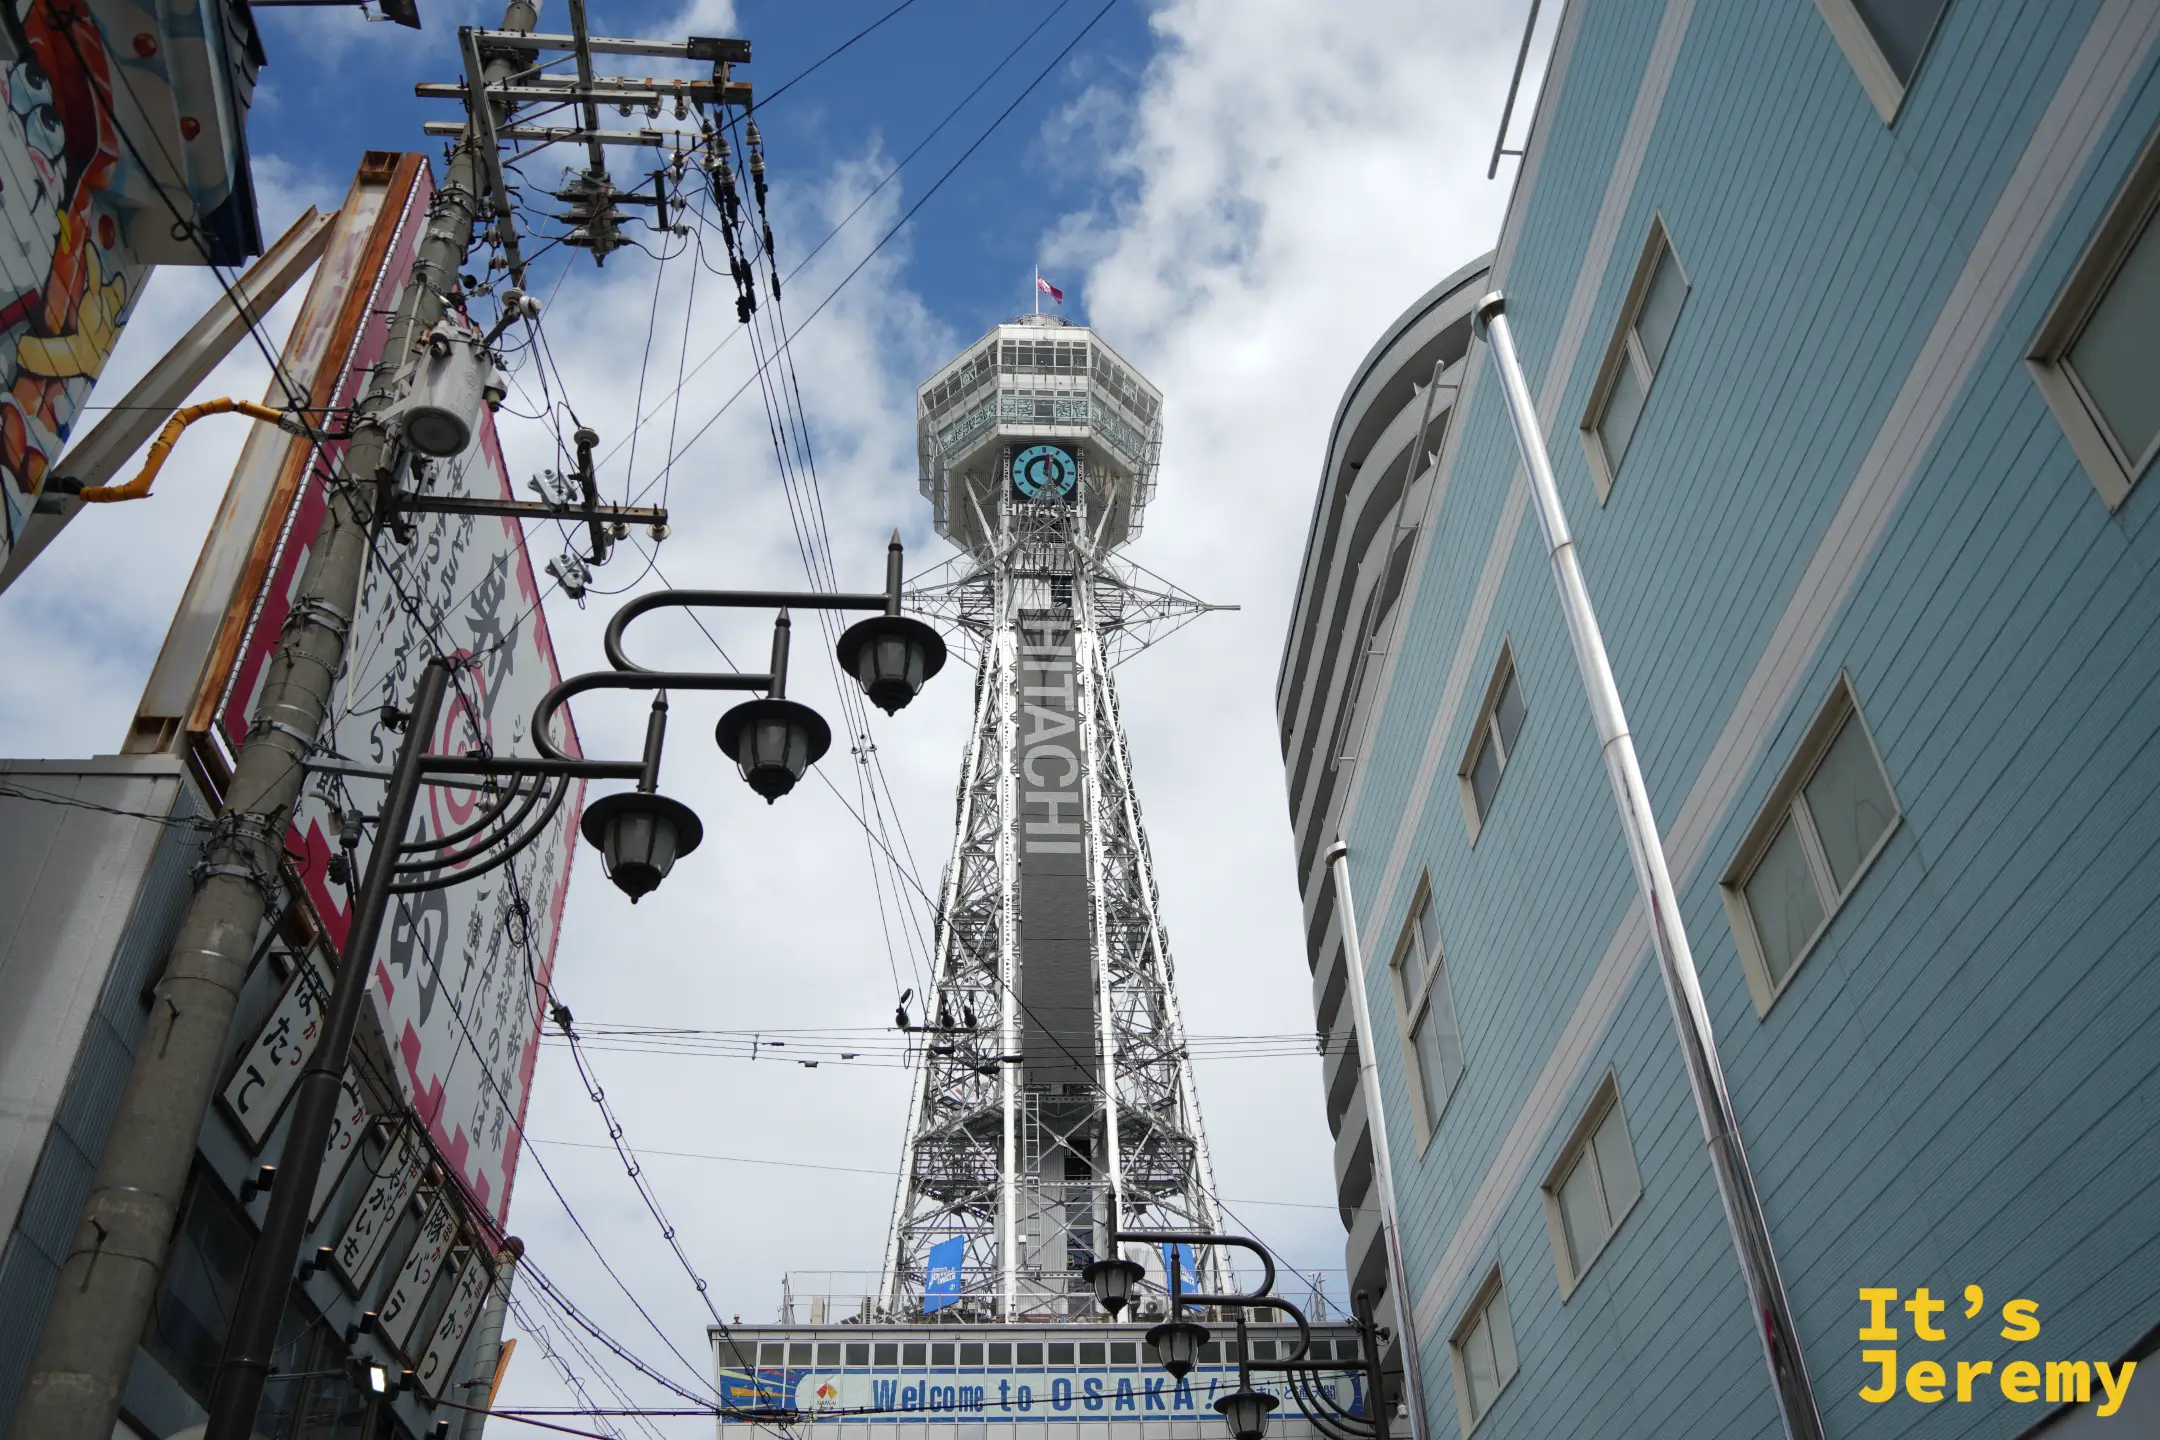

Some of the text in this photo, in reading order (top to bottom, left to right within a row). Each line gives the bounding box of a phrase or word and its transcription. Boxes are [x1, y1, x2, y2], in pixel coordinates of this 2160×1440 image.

[1022, 620, 1080, 854] HITACHI
[384, 1202, 449, 1322] 豚バラ
[422, 1223, 453, 1284] 串かつ
[424, 1265, 477, 1379] 牛かつ
[456, 1280, 484, 1339] 串かつ
[873, 1378, 1217, 1412] Welcome to OSAKA!
